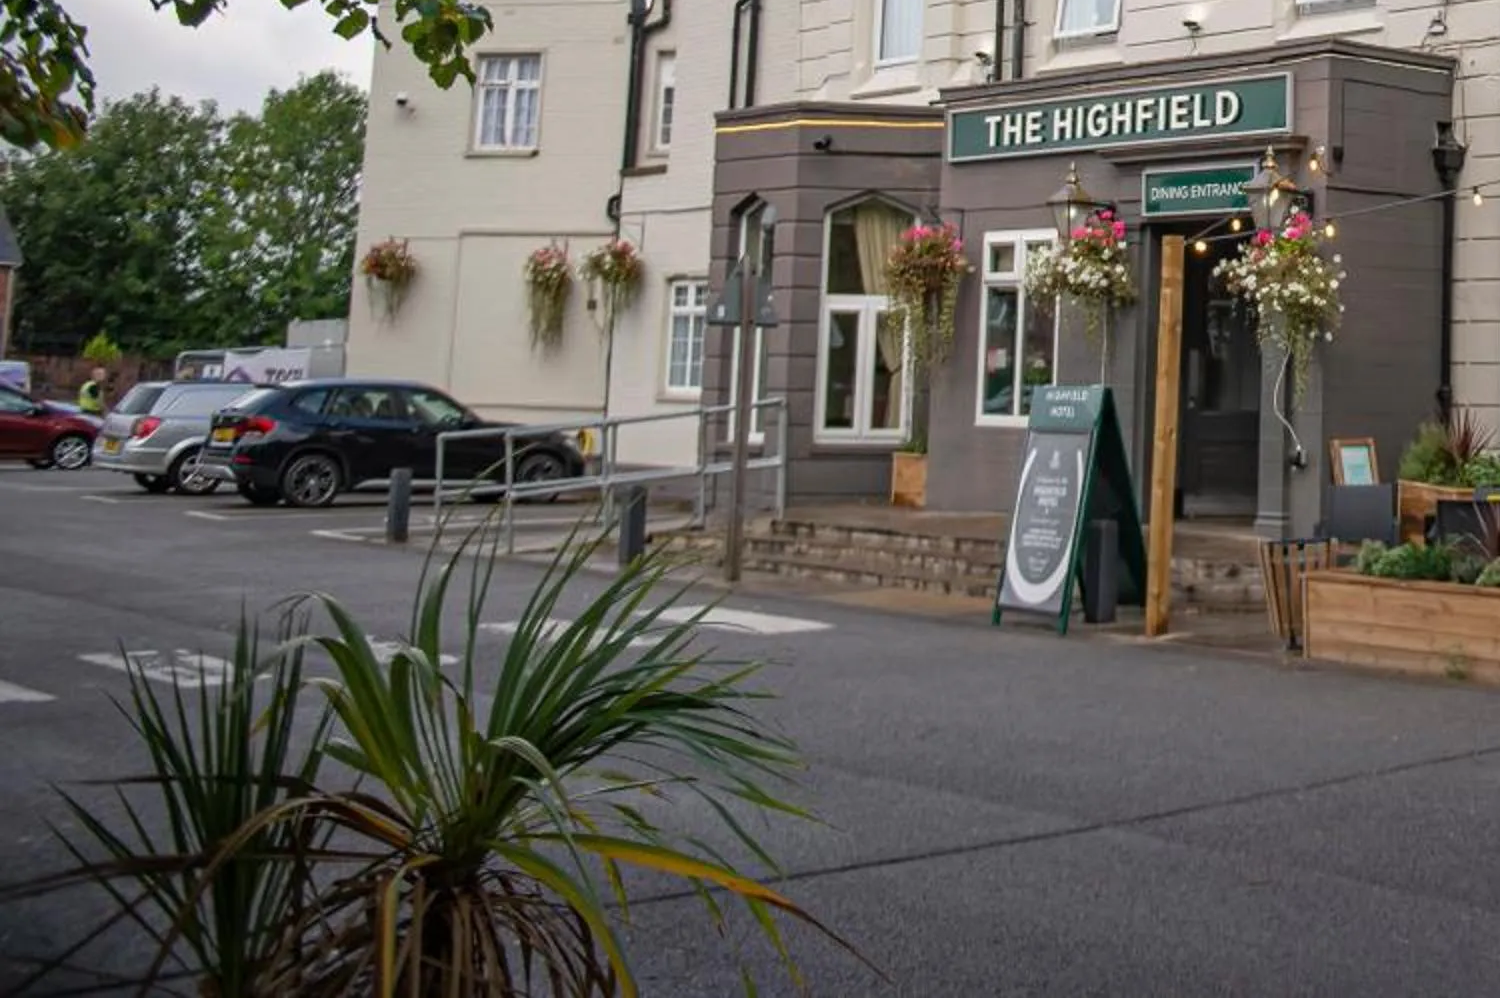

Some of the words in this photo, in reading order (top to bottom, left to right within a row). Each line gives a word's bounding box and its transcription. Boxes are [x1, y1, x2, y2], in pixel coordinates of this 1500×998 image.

[985, 111, 1042, 147] THE
[1053, 90, 1239, 141] HIGHFIELD
[1151, 185, 1189, 201] DINING
